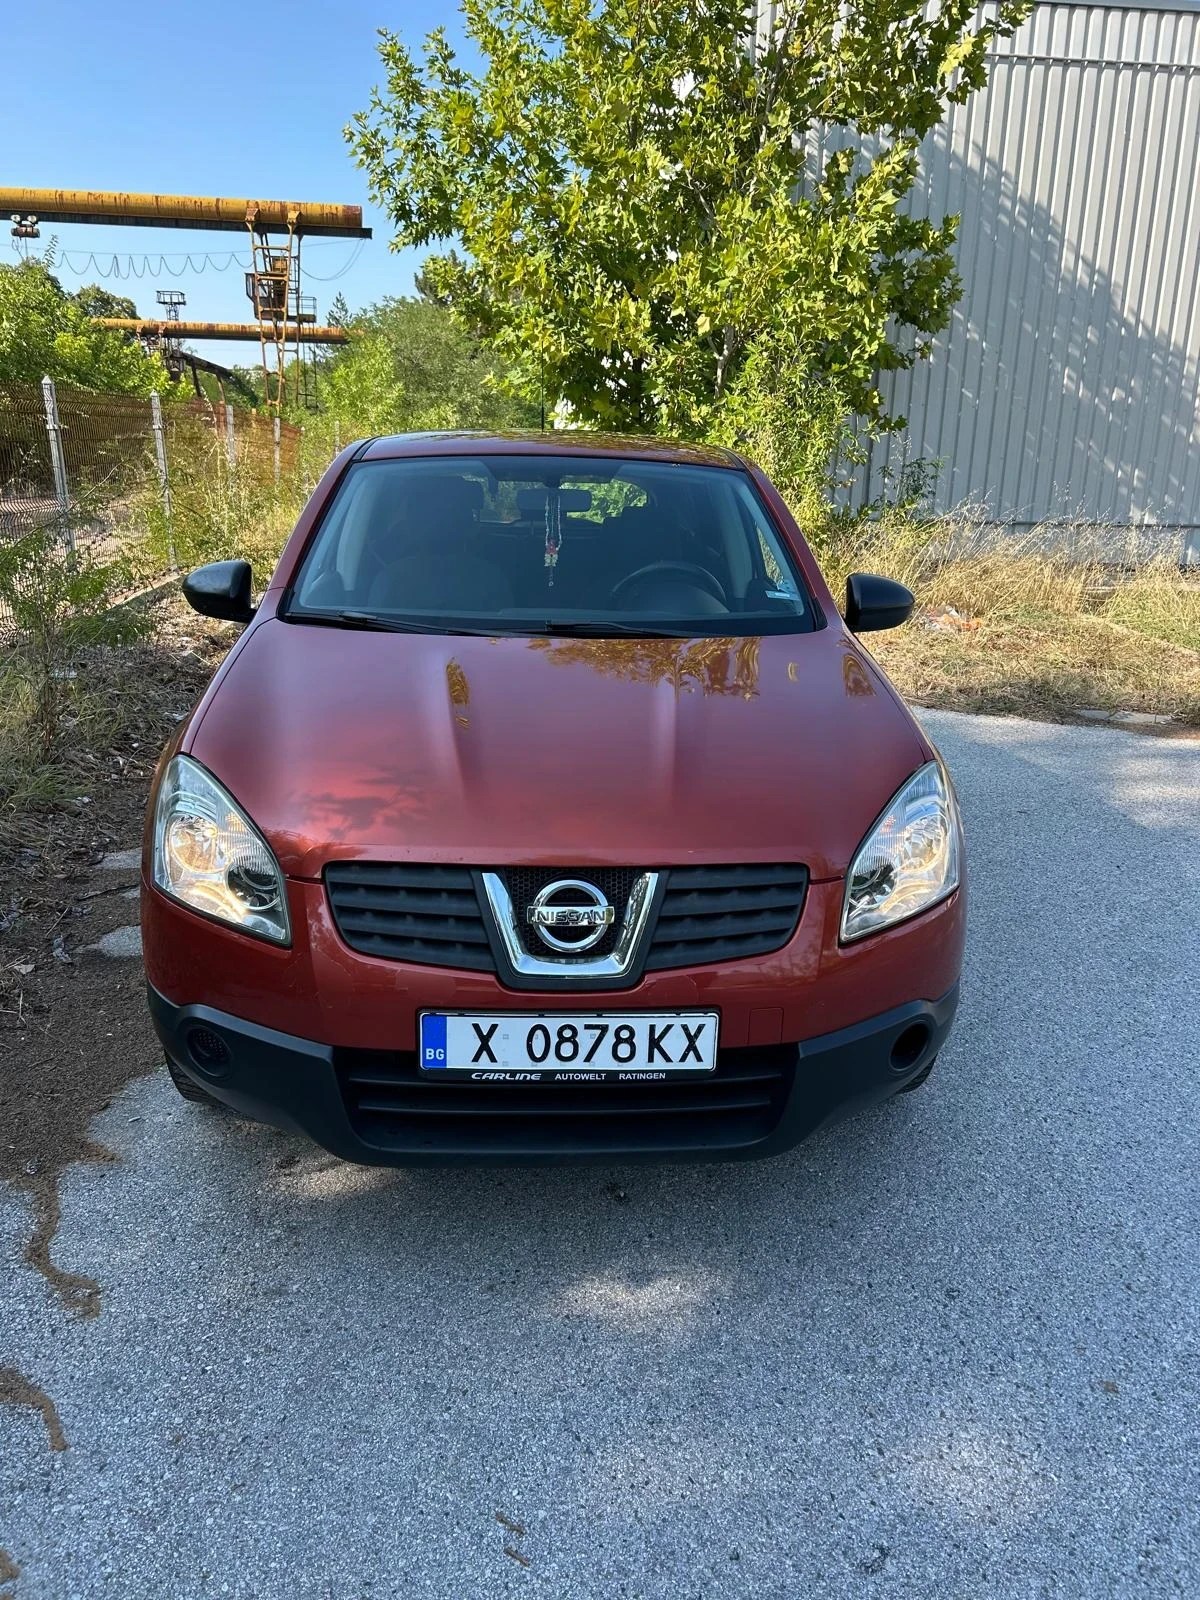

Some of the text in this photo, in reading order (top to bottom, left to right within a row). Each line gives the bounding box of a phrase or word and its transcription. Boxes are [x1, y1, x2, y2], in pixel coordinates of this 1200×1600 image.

[536, 909, 606, 923] NISSAN
[471, 1023, 499, 1063] X
[425, 1048, 445, 1060] BG
[471, 1072, 667, 1081] CARLINE AUTOWELT RATINGEN
